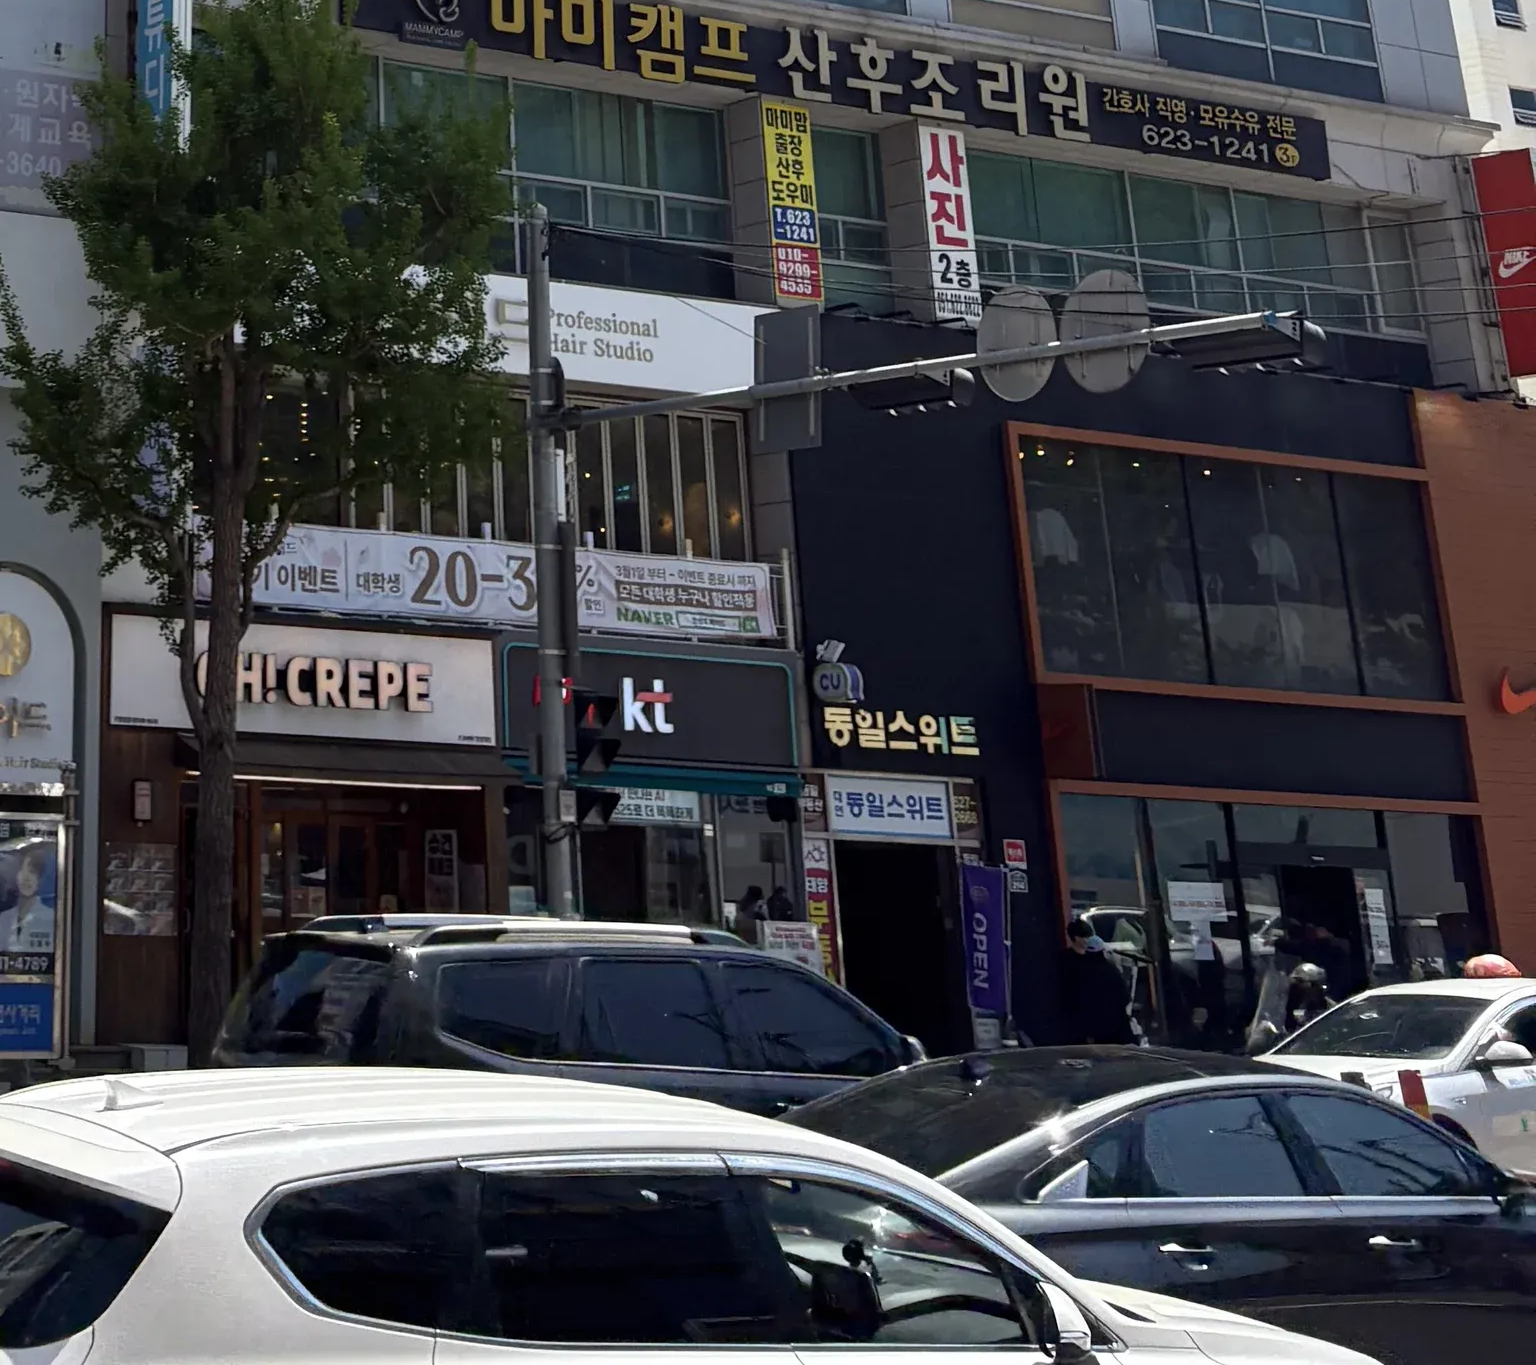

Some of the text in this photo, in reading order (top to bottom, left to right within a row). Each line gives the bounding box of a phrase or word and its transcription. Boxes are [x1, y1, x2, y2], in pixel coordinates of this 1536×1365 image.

[777, 26, 1092, 143] 산후조리원
[765, 107, 808, 134] 마미맘
[1102, 88, 1297, 141] 간호사 직영 모유수유 전문
[774, 132, 803, 157] 출장
[1142, 124, 1270, 164] 623-1241
[776, 157, 805, 181] 산후
[771, 180, 814, 207] 도우미
[926, 132, 969, 249] 사진
[775, 208, 811, 226] T.623
[776, 226, 815, 242] -1241
[938, 252, 972, 289] 2층
[594, 338, 655, 363] Studio
[276, 562, 340, 594] 이벤트
[356, 571, 403, 595] 대학생
[617, 606, 675, 626] NAVER
[286, 656, 434, 713] CREPE
[819, 673, 841, 691] CU
[621, 676, 675, 735] kt
[823, 706, 980, 756] 동일스위트
[846, 791, 945, 821] 동일스위트
[805, 876, 829, 894] 태양
[972, 912, 989, 989] OPEN
